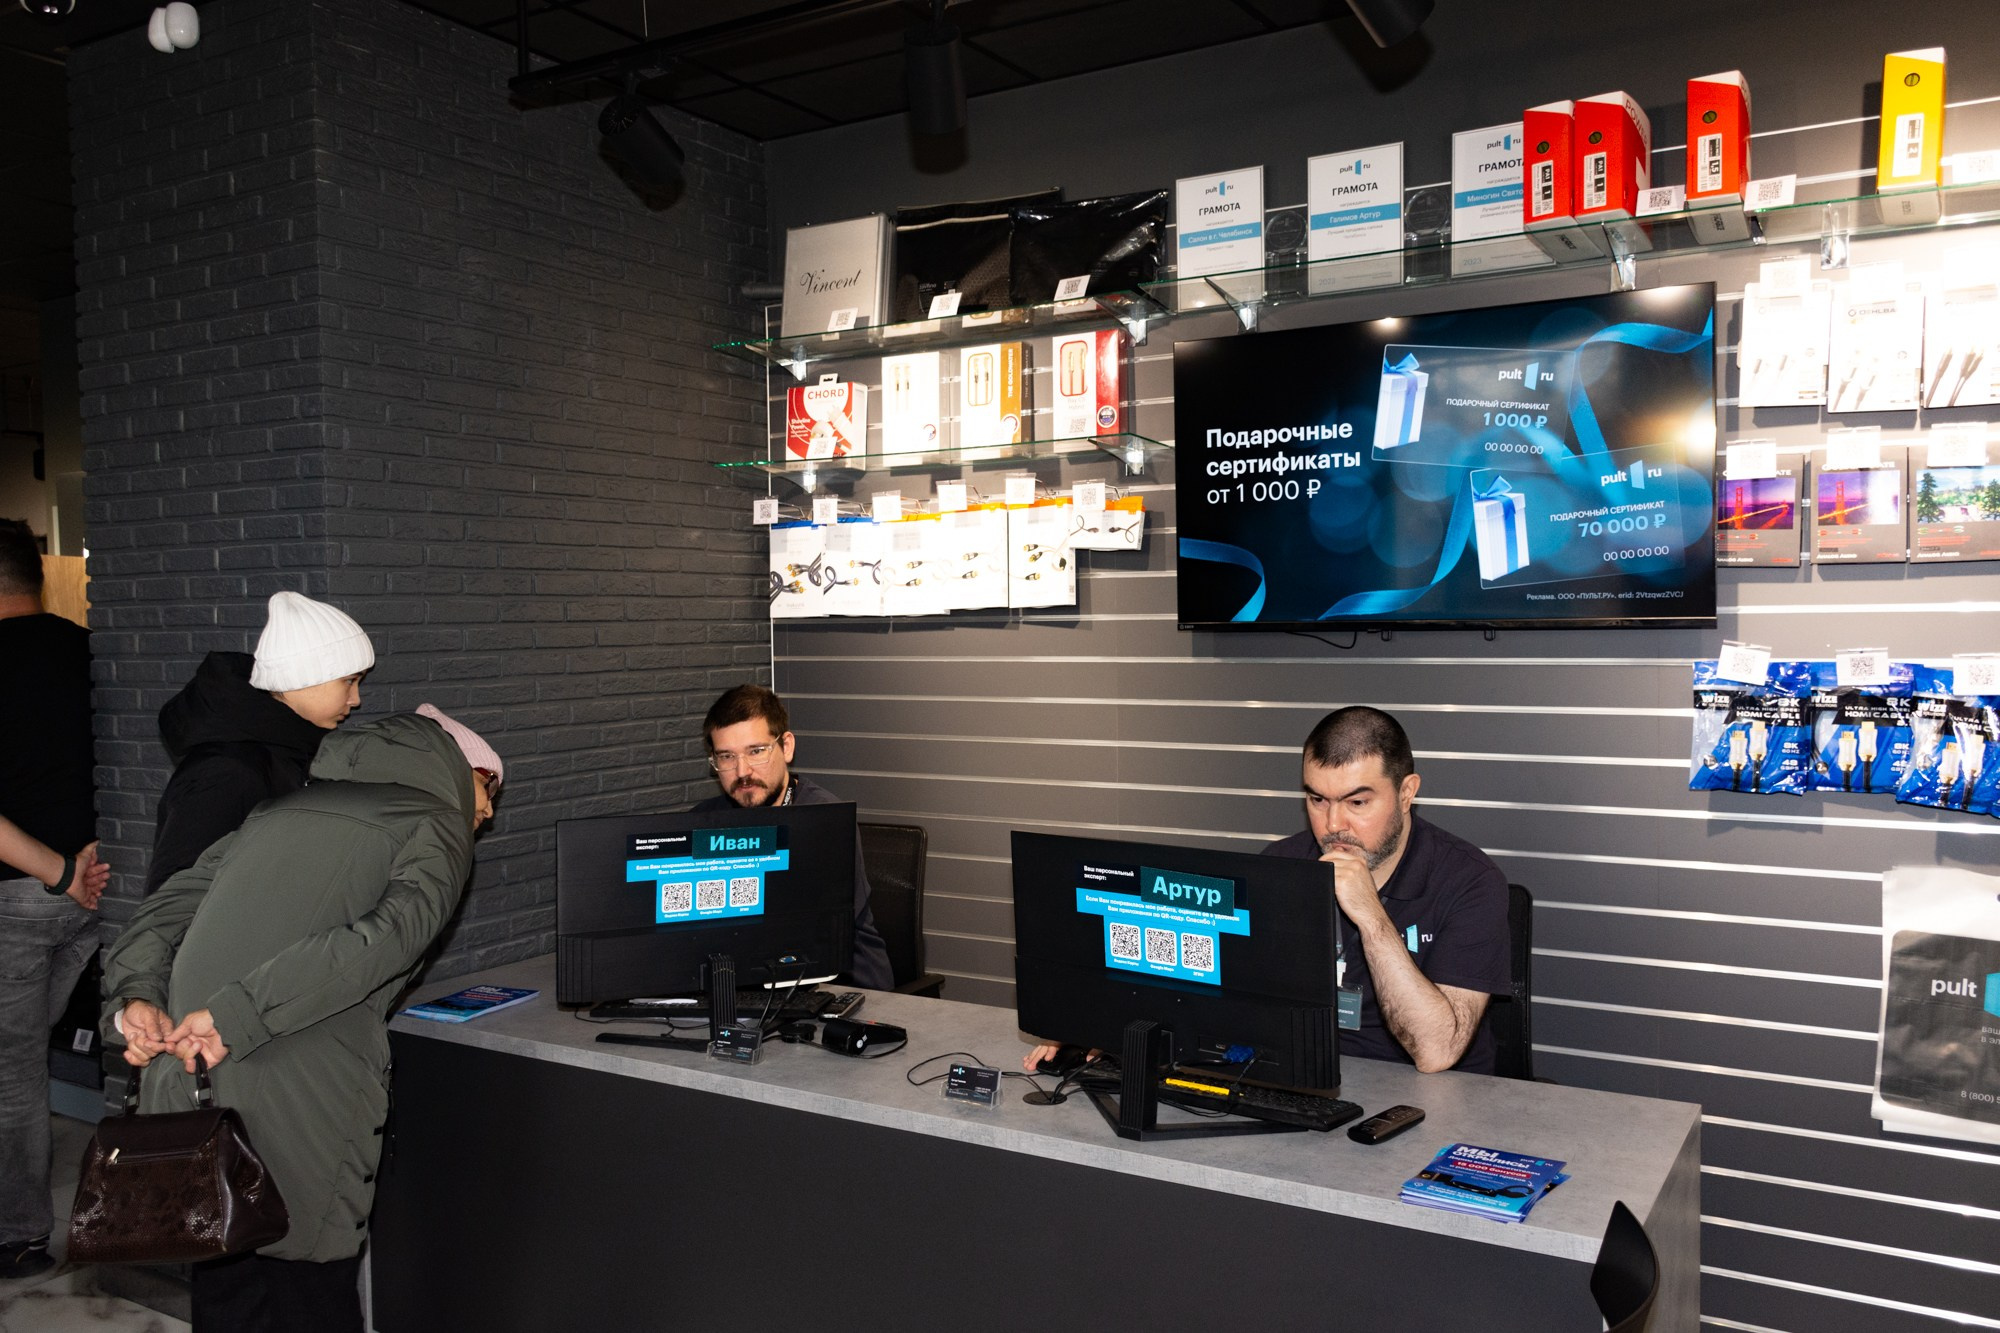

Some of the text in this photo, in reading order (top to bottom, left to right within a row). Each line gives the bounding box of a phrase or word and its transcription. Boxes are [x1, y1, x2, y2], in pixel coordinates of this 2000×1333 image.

[1486, 140, 1501, 150] pult
[1340, 165, 1353, 174] pult
[1205, 186, 1218, 195] pult
[1332, 182, 1378, 196] ГРАМОТА
[1199, 202, 1241, 216] ГРАМОТА
[1329, 211, 1381, 223] Галимов Артур
[800, 268, 862, 295] Vincent
[1498, 368, 1554, 381] pult ru
[808, 389, 845, 400] CHORD
[1446, 398, 1550, 411] ПОДАРОЧНЫЙ СЕРТИФИКАТ
[1483, 412, 1491, 426] 1
[1494, 413, 1532, 428] 000
[1206, 422, 1353, 449] Подарочные
[1206, 451, 1361, 479] сертификаты
[1600, 468, 1662, 486] pult ru
[1207, 489, 1231, 504] от
[1252, 480, 1300, 502] 000
[1550, 500, 1665, 522] ПОДАРОЧНЫЙ СЕРТИФИКАТ
[1578, 521, 1603, 538] 70
[1607, 515, 1649, 534] 000
[1526, 593, 1556, 601] Реклама.
[1557, 592, 1575, 600] ООО
[1886, 697, 1911, 707] 8K
[710, 835, 760, 851] Иван
[1152, 875, 1222, 907] Артур
[1421, 933, 1433, 943] ru
[1931, 978, 1977, 998] pult
[1969, 1091, 1994, 1103] (800)
[1457, 1146, 1499, 1158] МЫ
